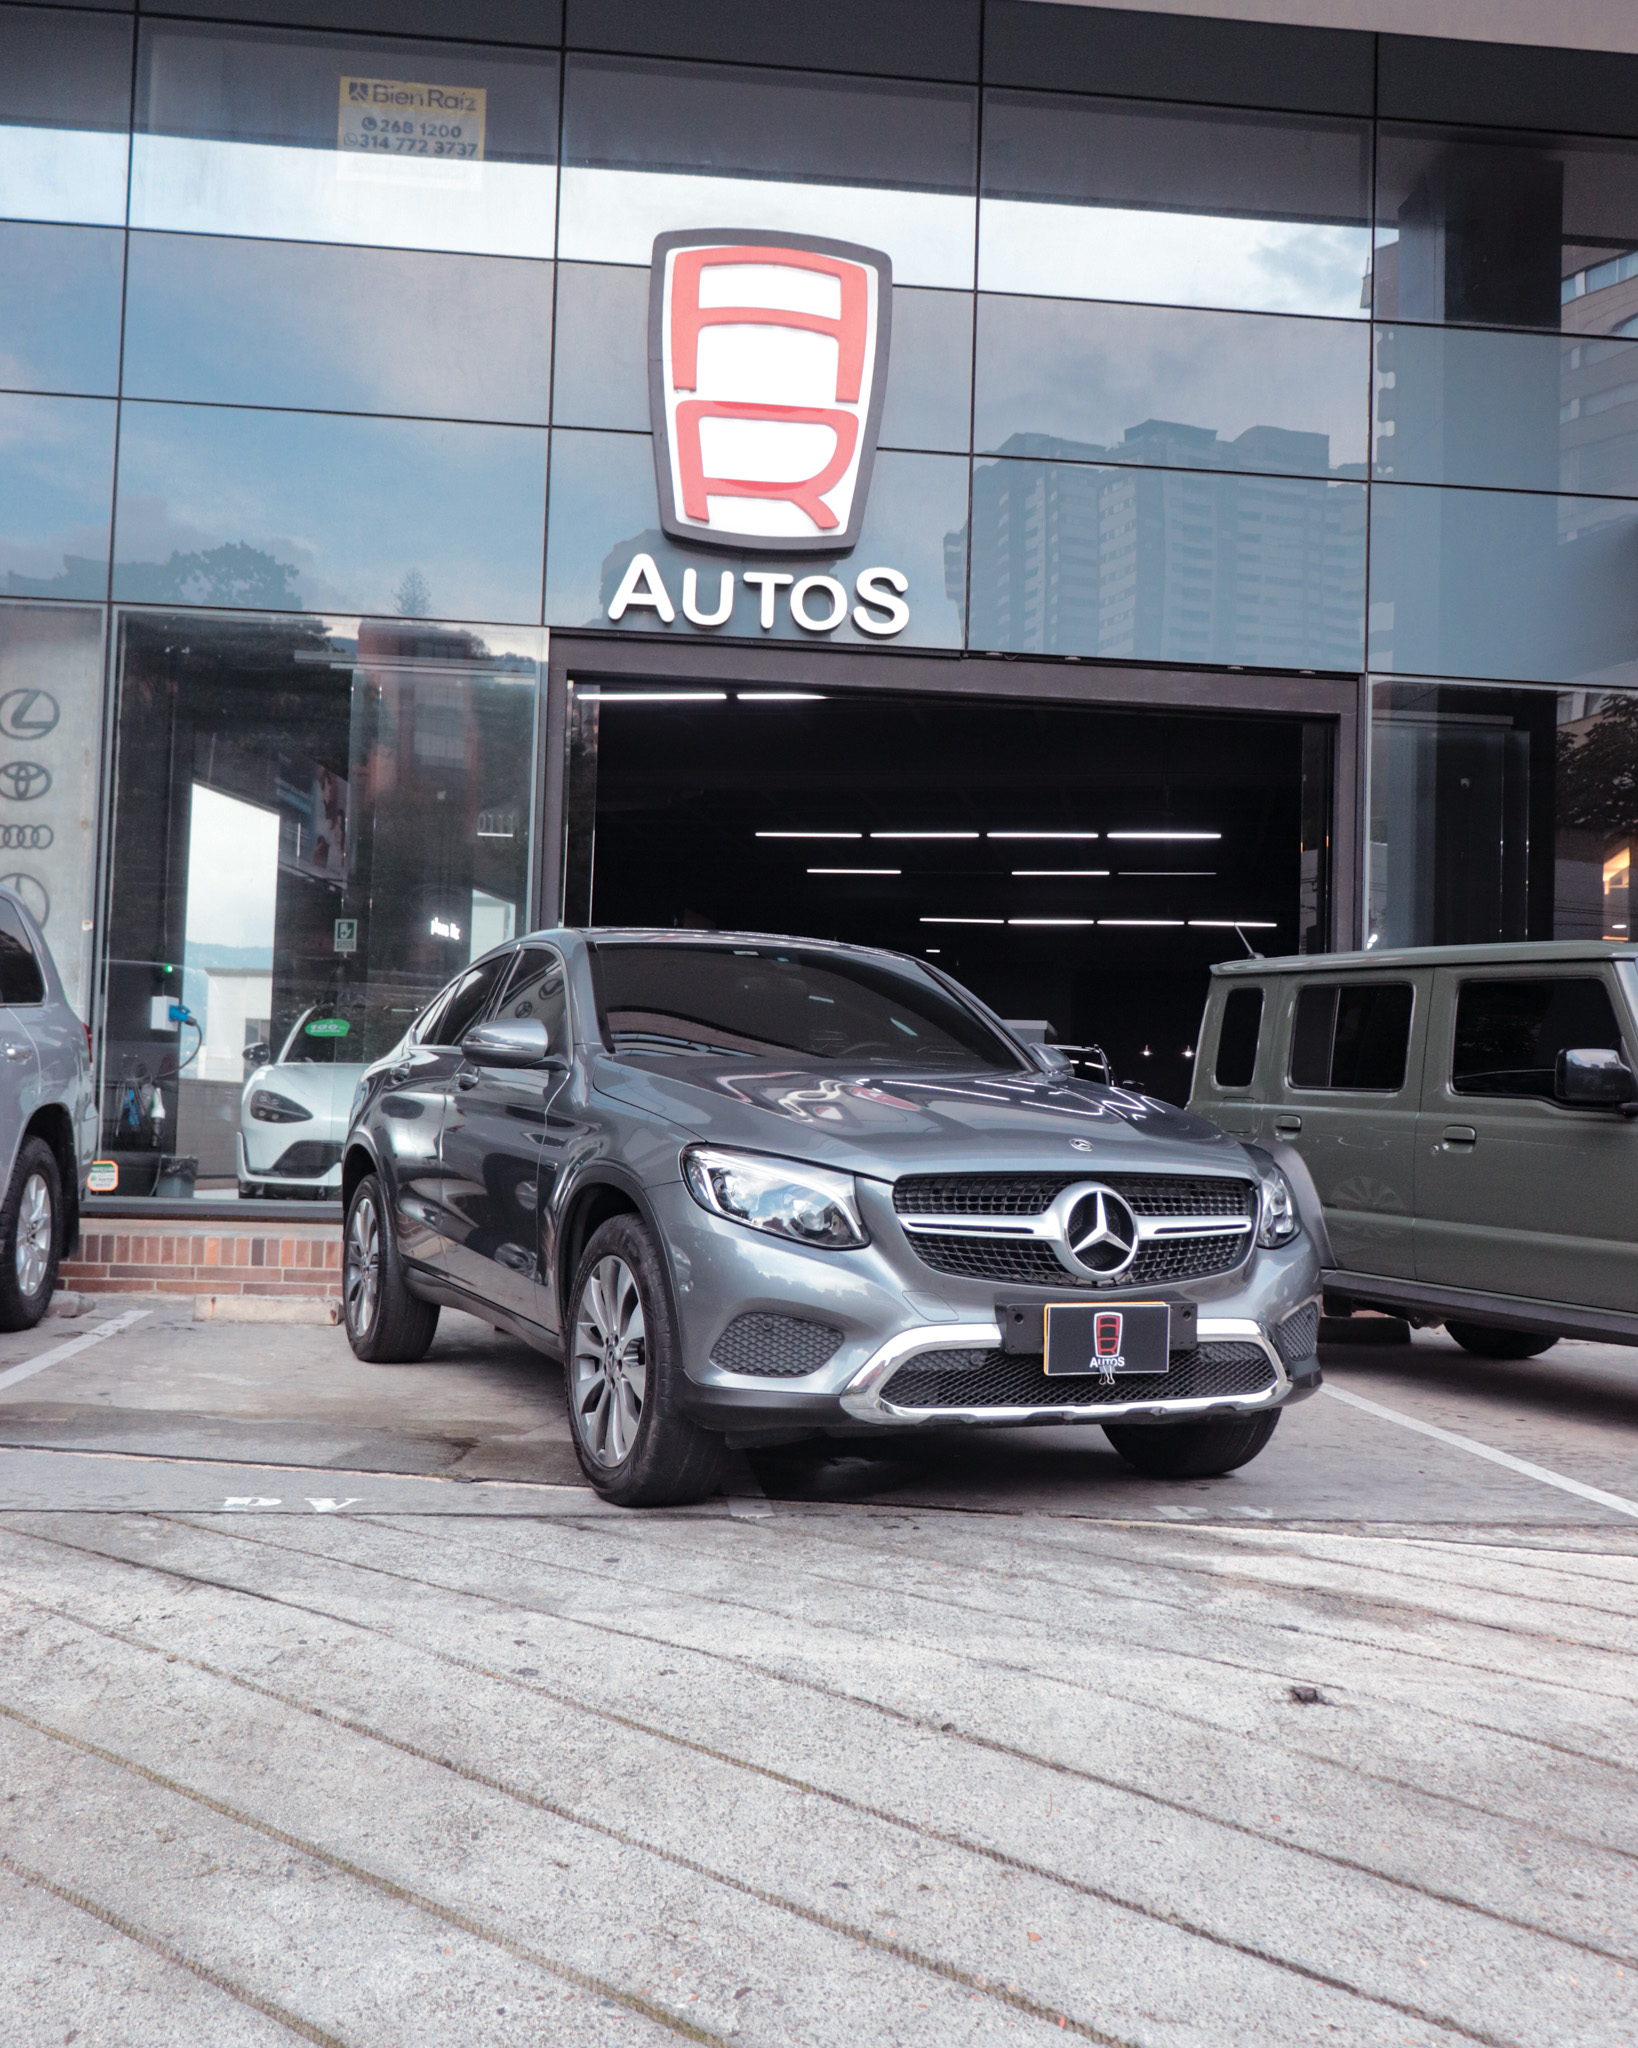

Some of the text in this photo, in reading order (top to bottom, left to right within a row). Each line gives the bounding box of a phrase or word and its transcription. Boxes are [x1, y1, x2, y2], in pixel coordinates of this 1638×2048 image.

[380, 119, 462, 139] 268 1200
[360, 134, 478, 157] 314 772 3737
[608, 553, 910, 635] AUTOS
